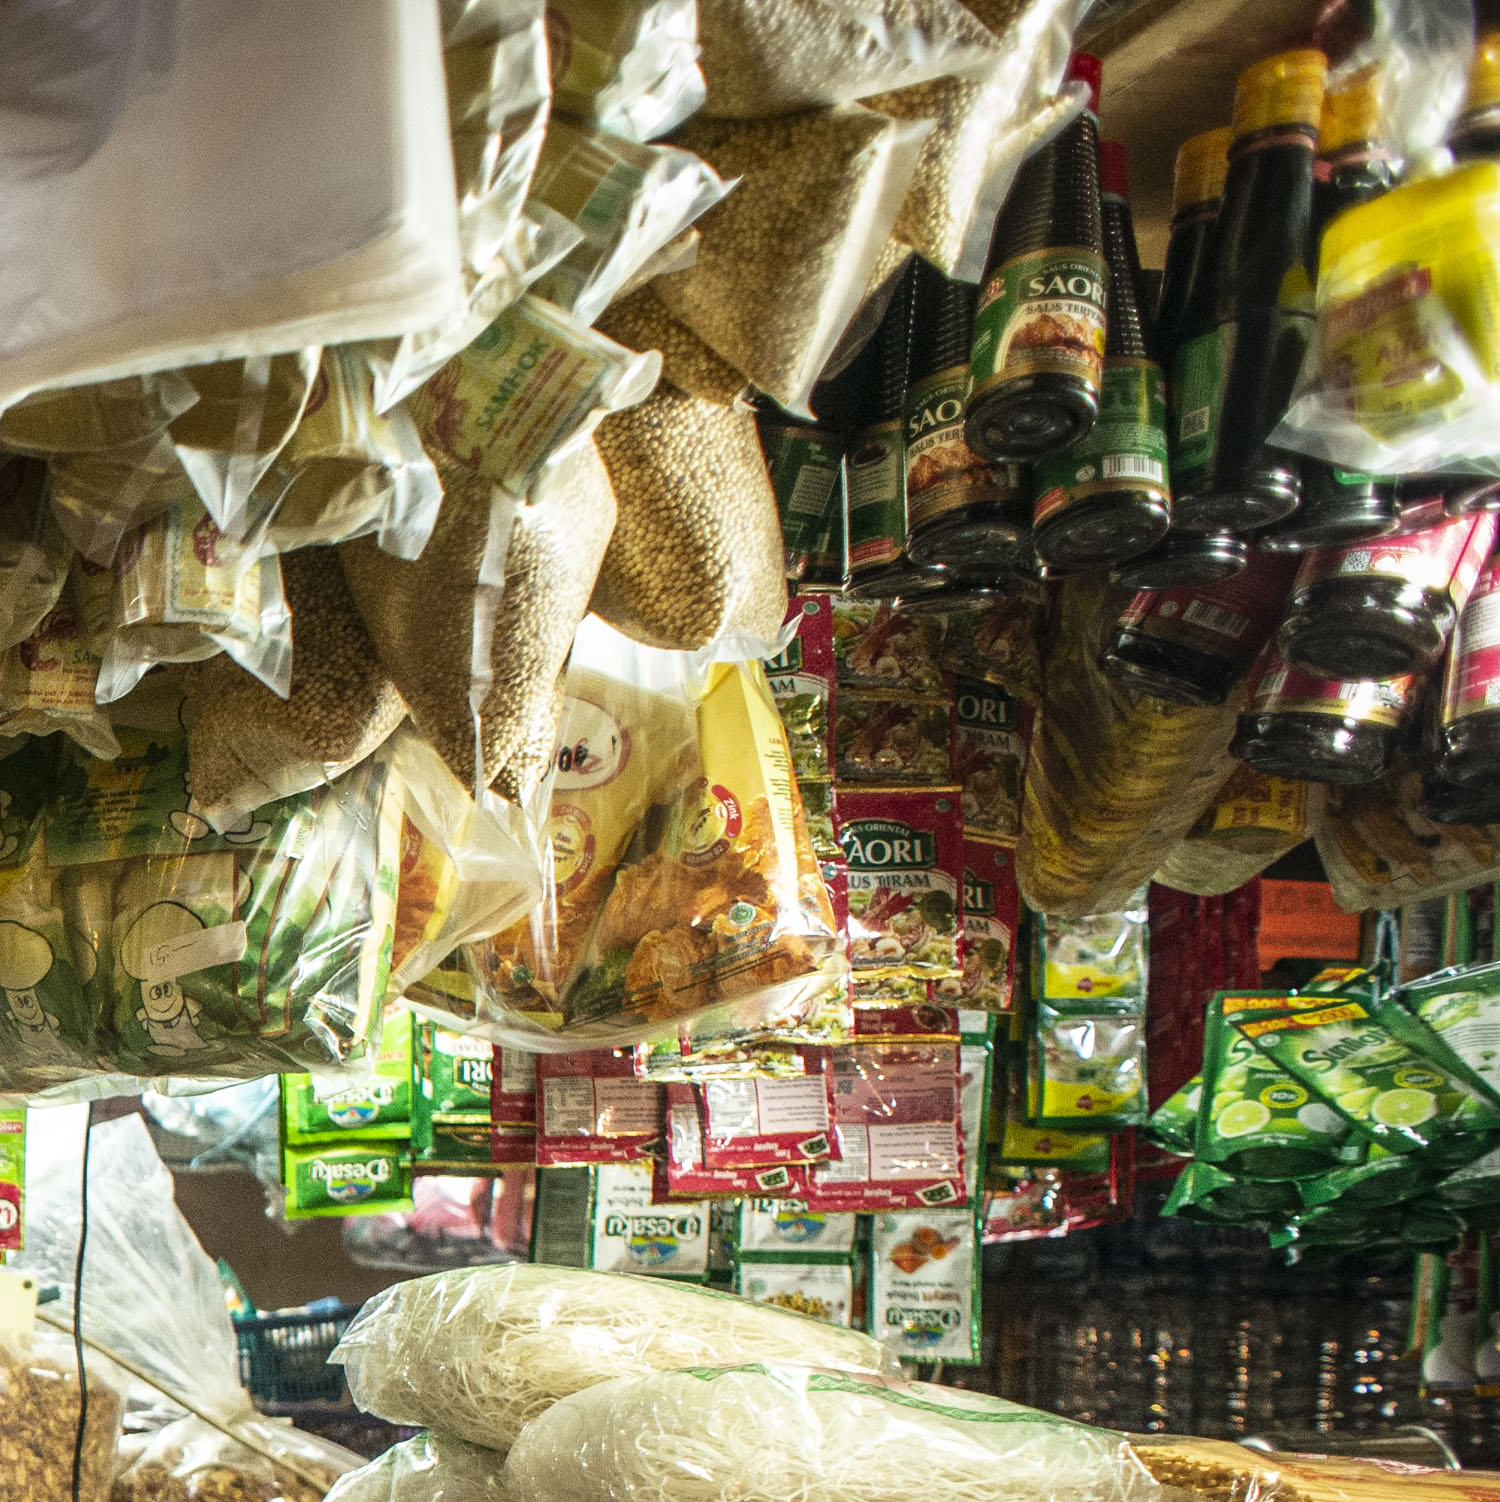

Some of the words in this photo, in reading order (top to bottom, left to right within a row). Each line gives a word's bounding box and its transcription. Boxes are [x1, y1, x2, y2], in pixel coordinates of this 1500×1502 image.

[1028, 275, 1106, 310] SAORI
[909, 398, 962, 438] SAO
[959, 695, 1006, 723] ORI
[724, 798, 739, 821] Zink
[847, 839, 924, 865] AORI
[848, 875, 872, 889] US
[878, 873, 931, 890] TIRAM
[463, 1060, 492, 1083] ORI
[310, 1158, 390, 1183] Desaku
[603, 1211, 700, 1240] Desaku
